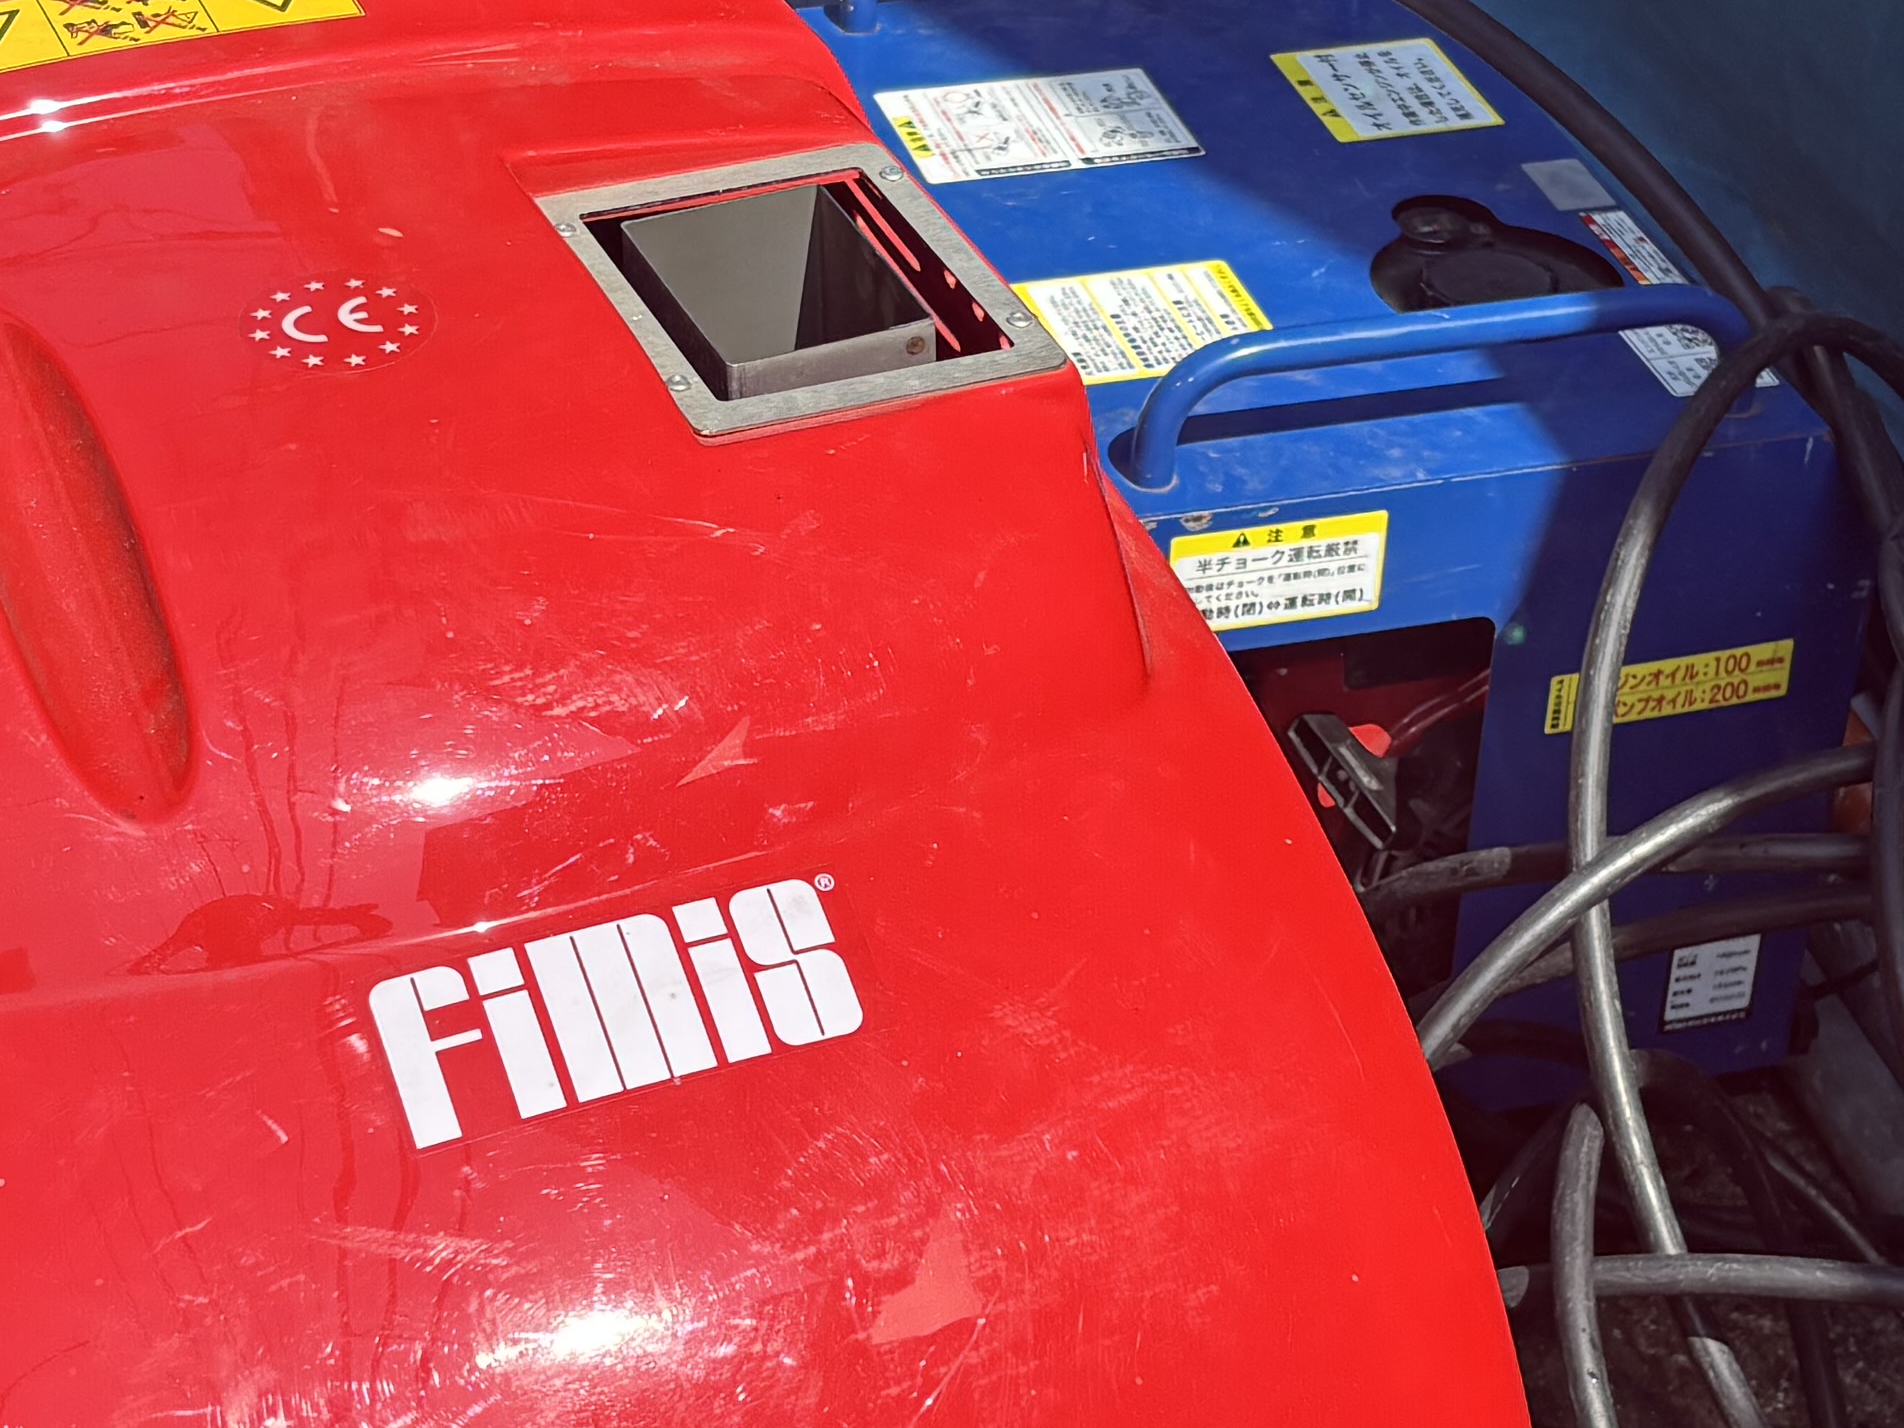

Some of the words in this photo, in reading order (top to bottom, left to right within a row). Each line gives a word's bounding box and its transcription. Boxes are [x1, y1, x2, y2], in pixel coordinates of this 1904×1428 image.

[1266, 523, 1318, 544] 注意
[1196, 539, 1360, 574] 半チョーク運転厳禁
